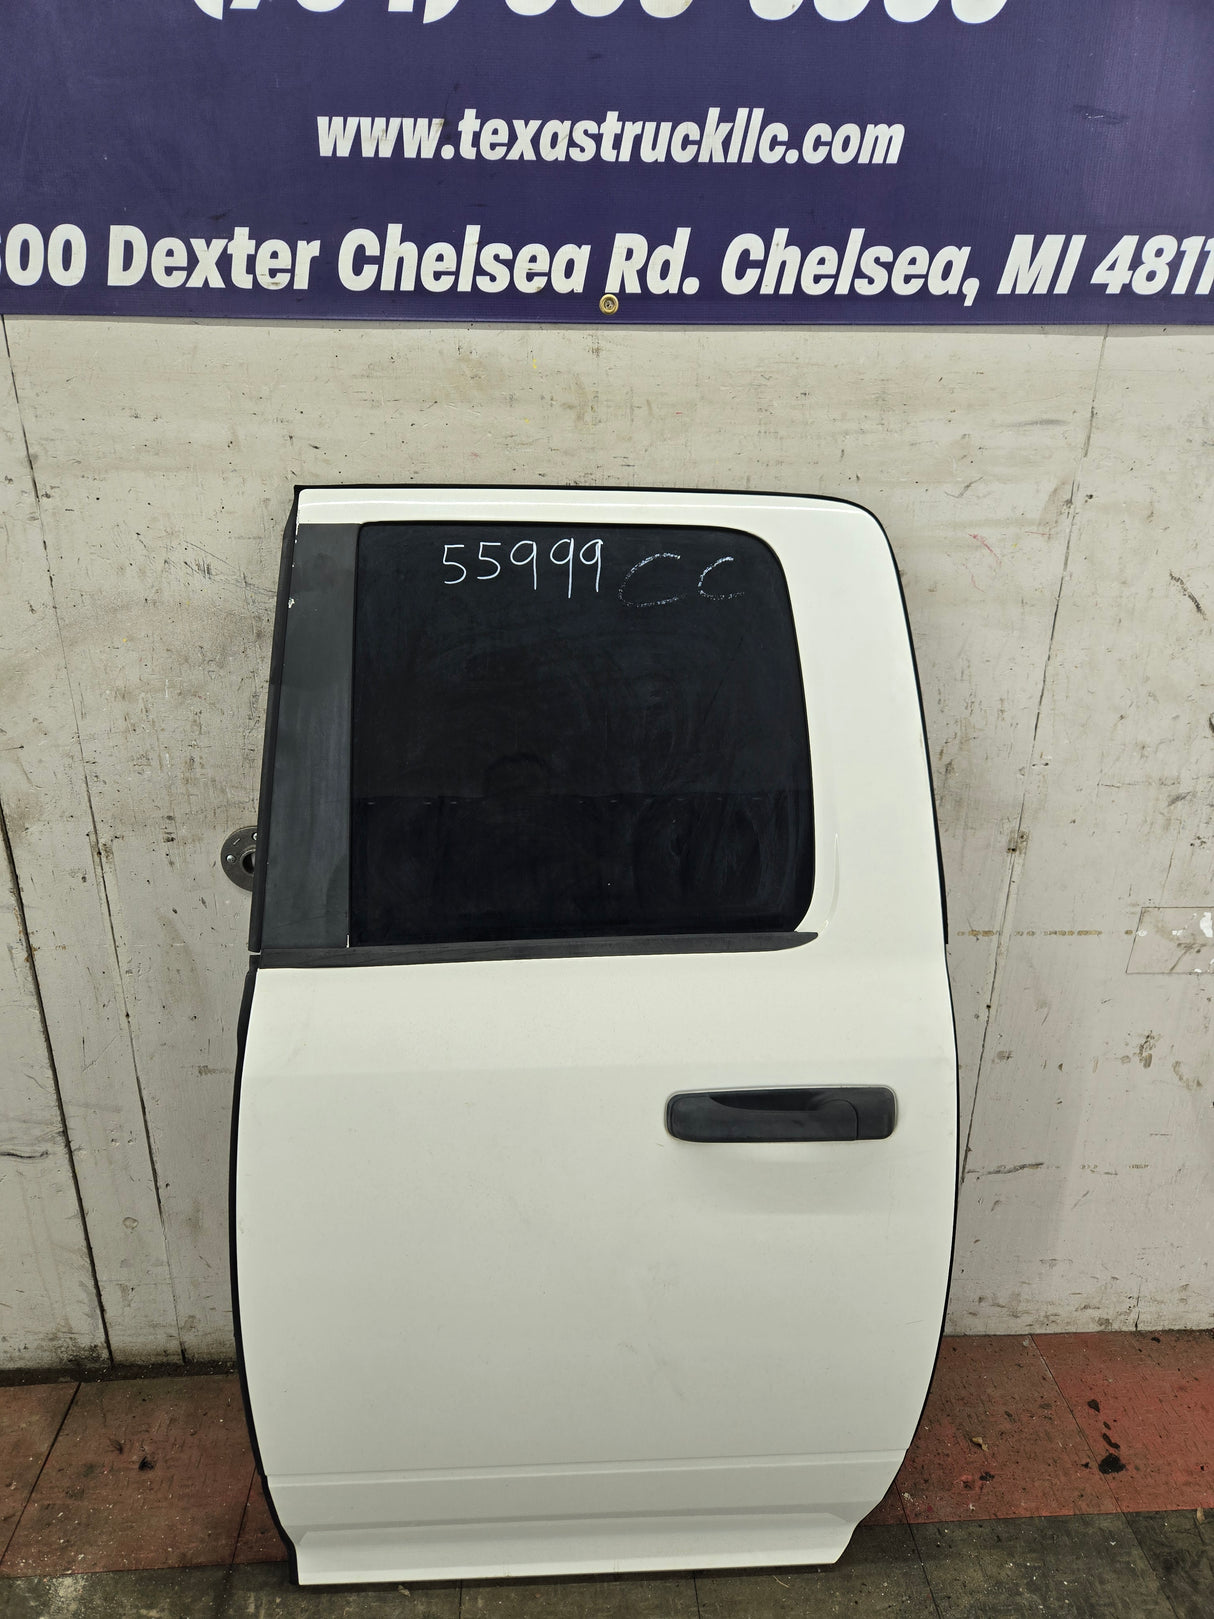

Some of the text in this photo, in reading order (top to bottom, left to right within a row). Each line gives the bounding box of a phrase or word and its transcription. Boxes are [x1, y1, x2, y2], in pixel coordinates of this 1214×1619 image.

[317, 107, 905, 165] www.texastruckllc.com
[0, 223, 86, 287] 00
[107, 225, 321, 290] Dexter
[338, 224, 592, 294] Chelsea
[605, 227, 700, 295] Rd.
[721, 228, 980, 307] Chelsea,
[997, 235, 1087, 295] MI
[442, 537, 604, 599] 55999
